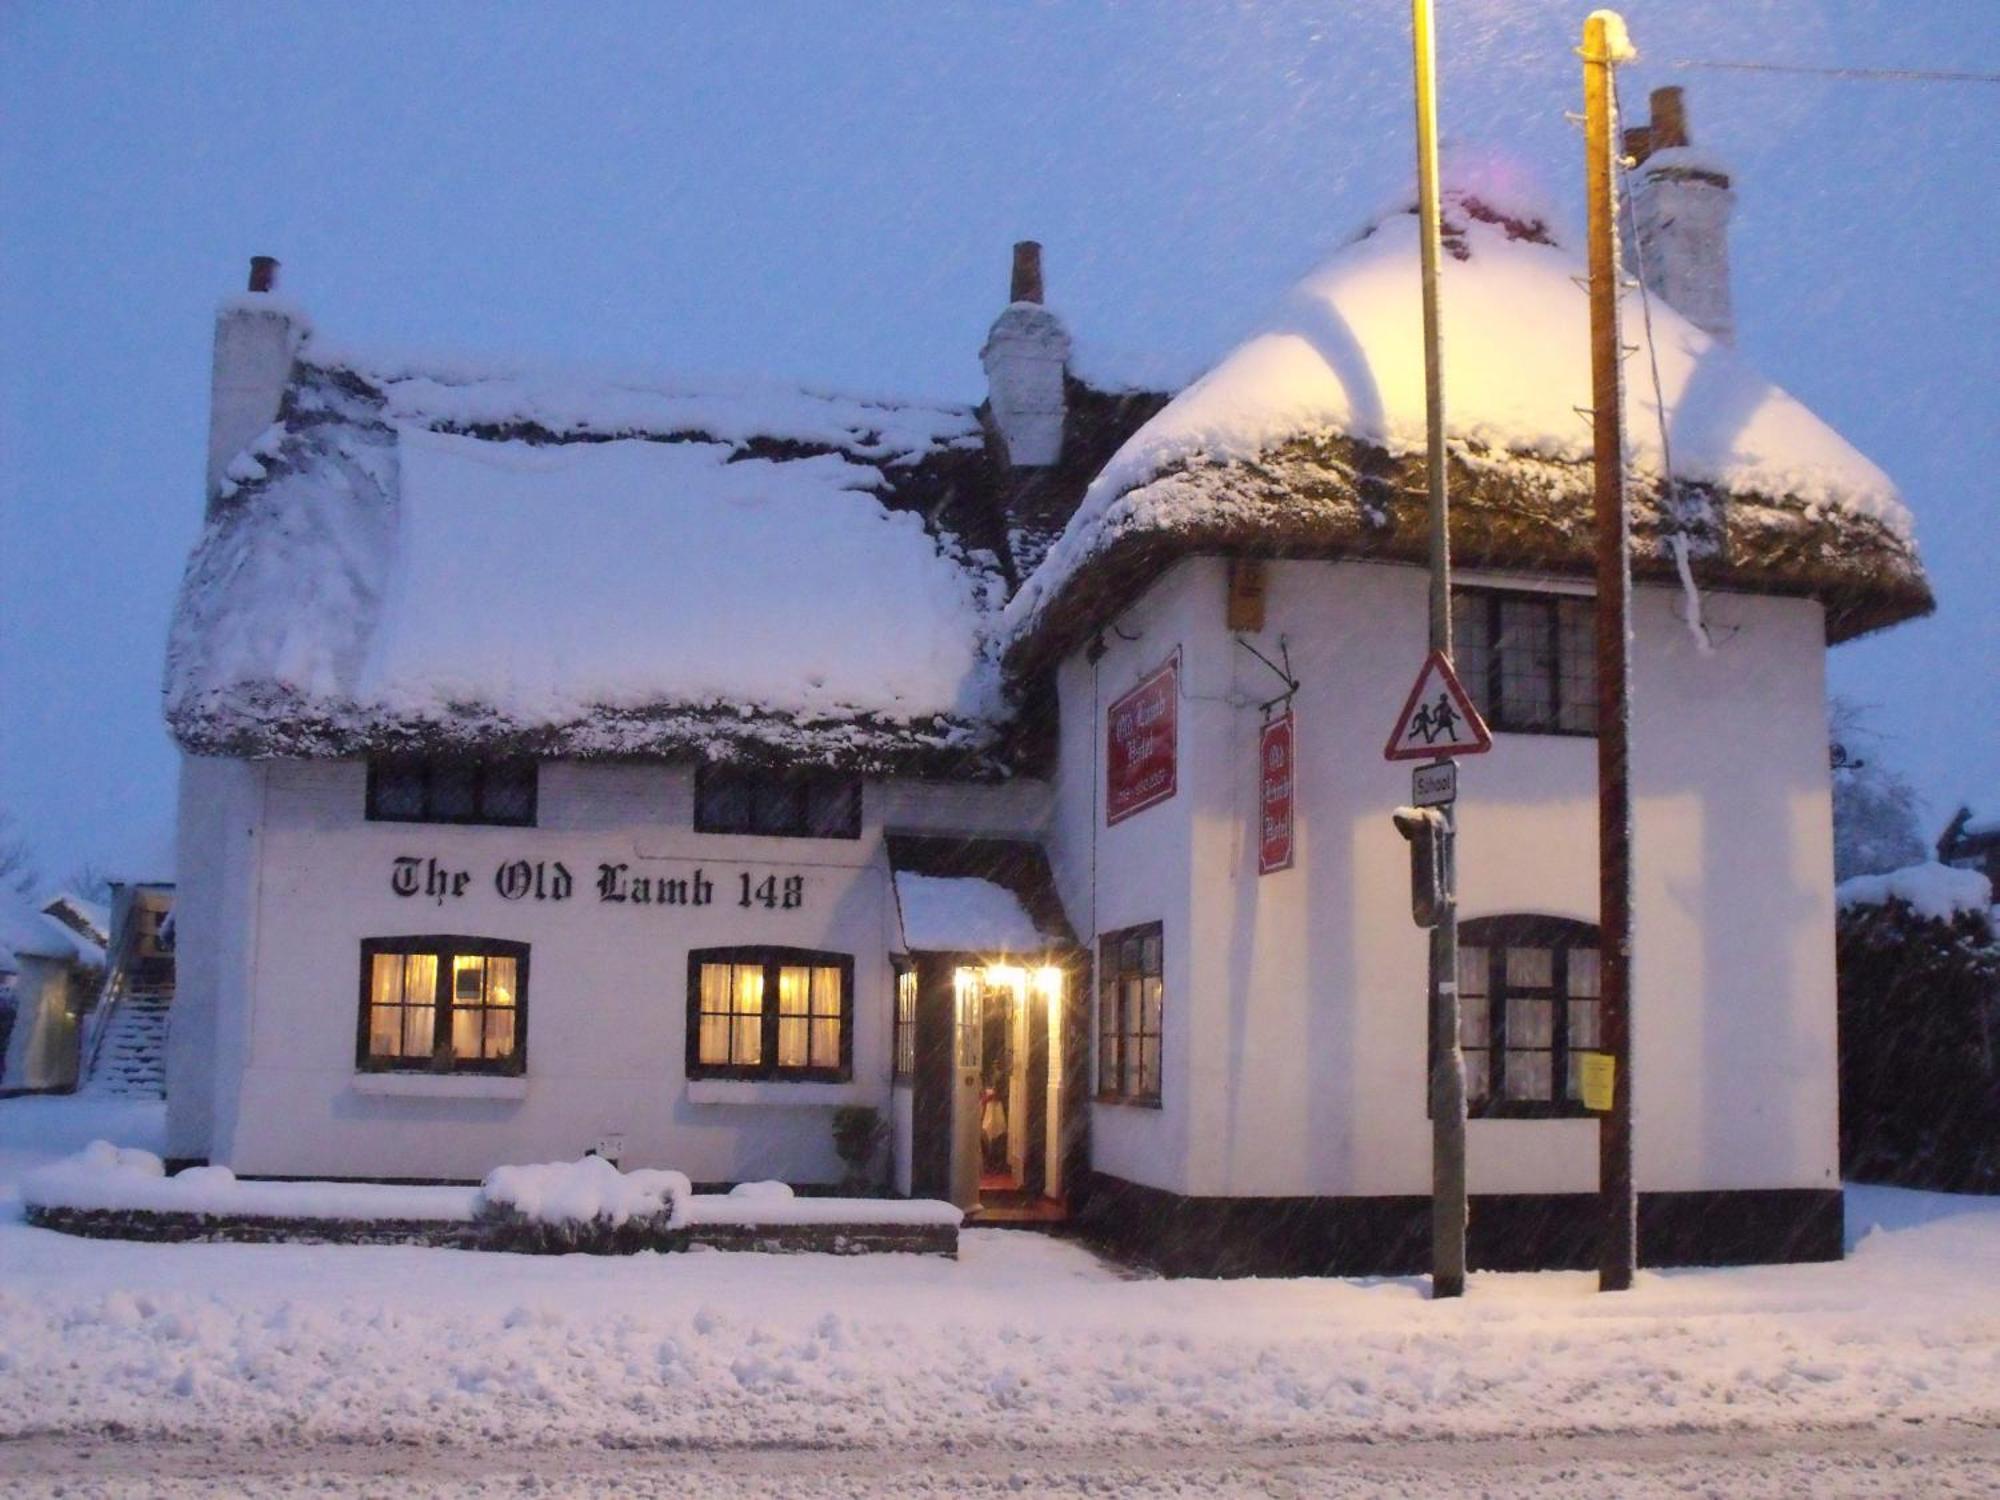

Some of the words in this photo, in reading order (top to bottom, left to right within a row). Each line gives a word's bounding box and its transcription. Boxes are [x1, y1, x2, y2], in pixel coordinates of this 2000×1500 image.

[1417, 773, 1451, 796] School
[392, 856, 471, 907] The
[495, 859, 573, 900] Old
[597, 863, 714, 907] Lamb
[738, 872, 804, 908] 148
